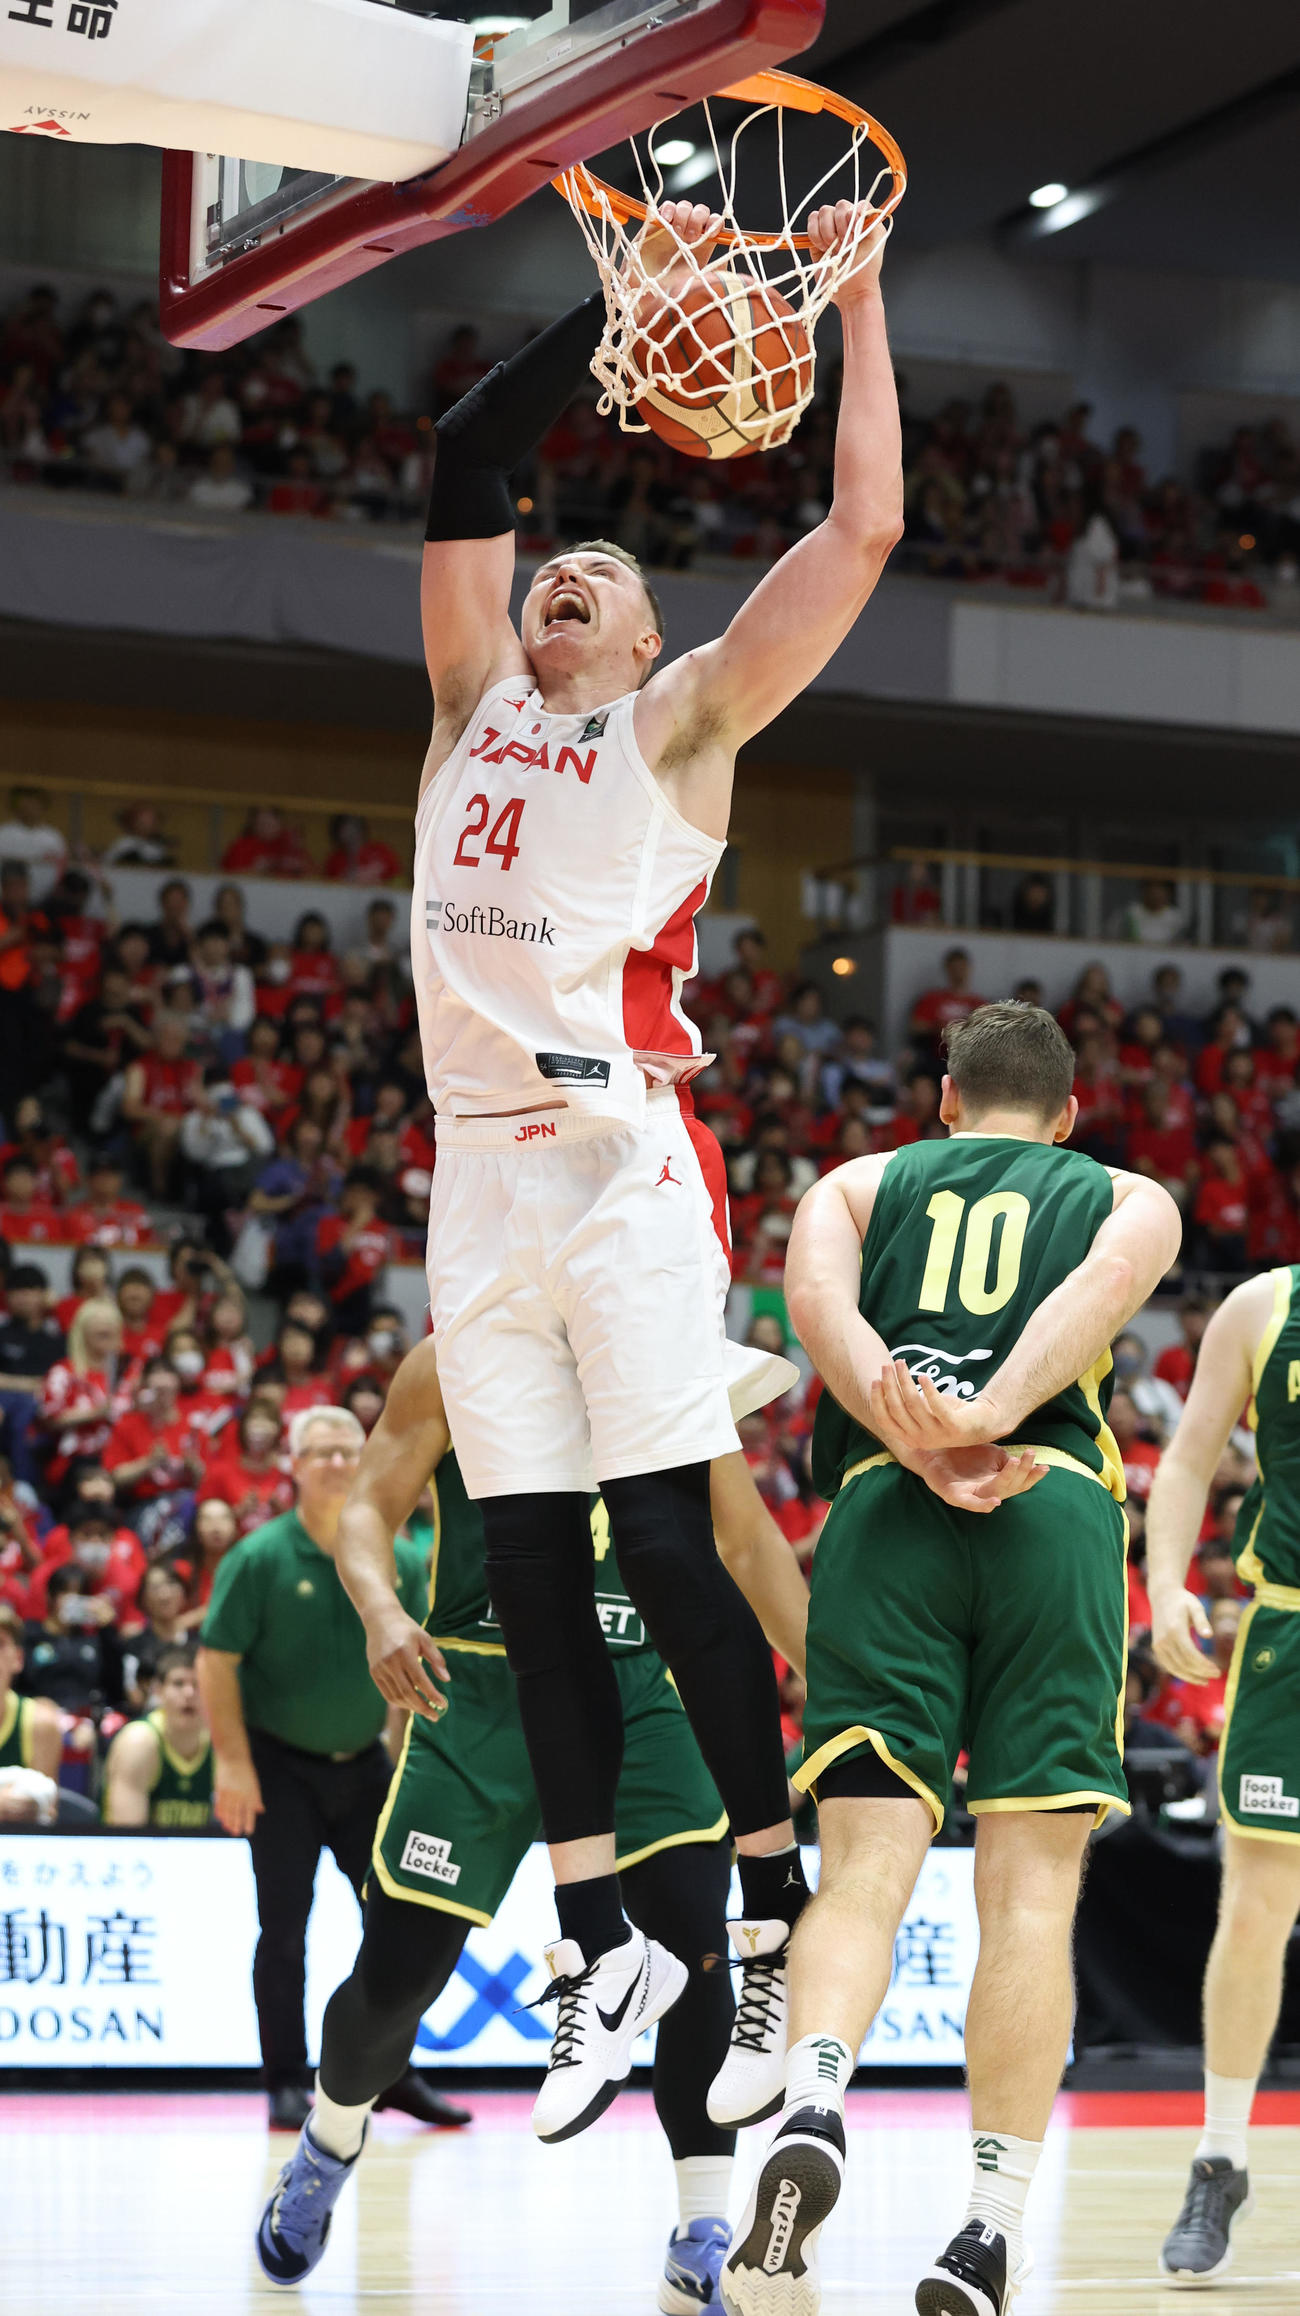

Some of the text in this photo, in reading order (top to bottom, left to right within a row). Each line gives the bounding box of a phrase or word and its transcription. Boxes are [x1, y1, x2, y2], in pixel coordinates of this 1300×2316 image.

[24, 105, 91, 121] NISSAY
[469, 726, 598, 785] JAPAN
[453, 793, 526, 871] 24
[443, 902, 556, 946] SoftBank
[514, 1122, 556, 1142] JPN
[917, 1189, 1031, 1316] 10
[596, 1603, 637, 1635] ET
[1245, 1779, 1277, 1794] Foot
[1244, 1795, 1294, 1811] Locker
[411, 1836, 444, 1858] Foot
[406, 1851, 456, 1879] Locker
[0, 1909, 161, 1986] 動産
[866, 2006, 963, 2042] SAN
